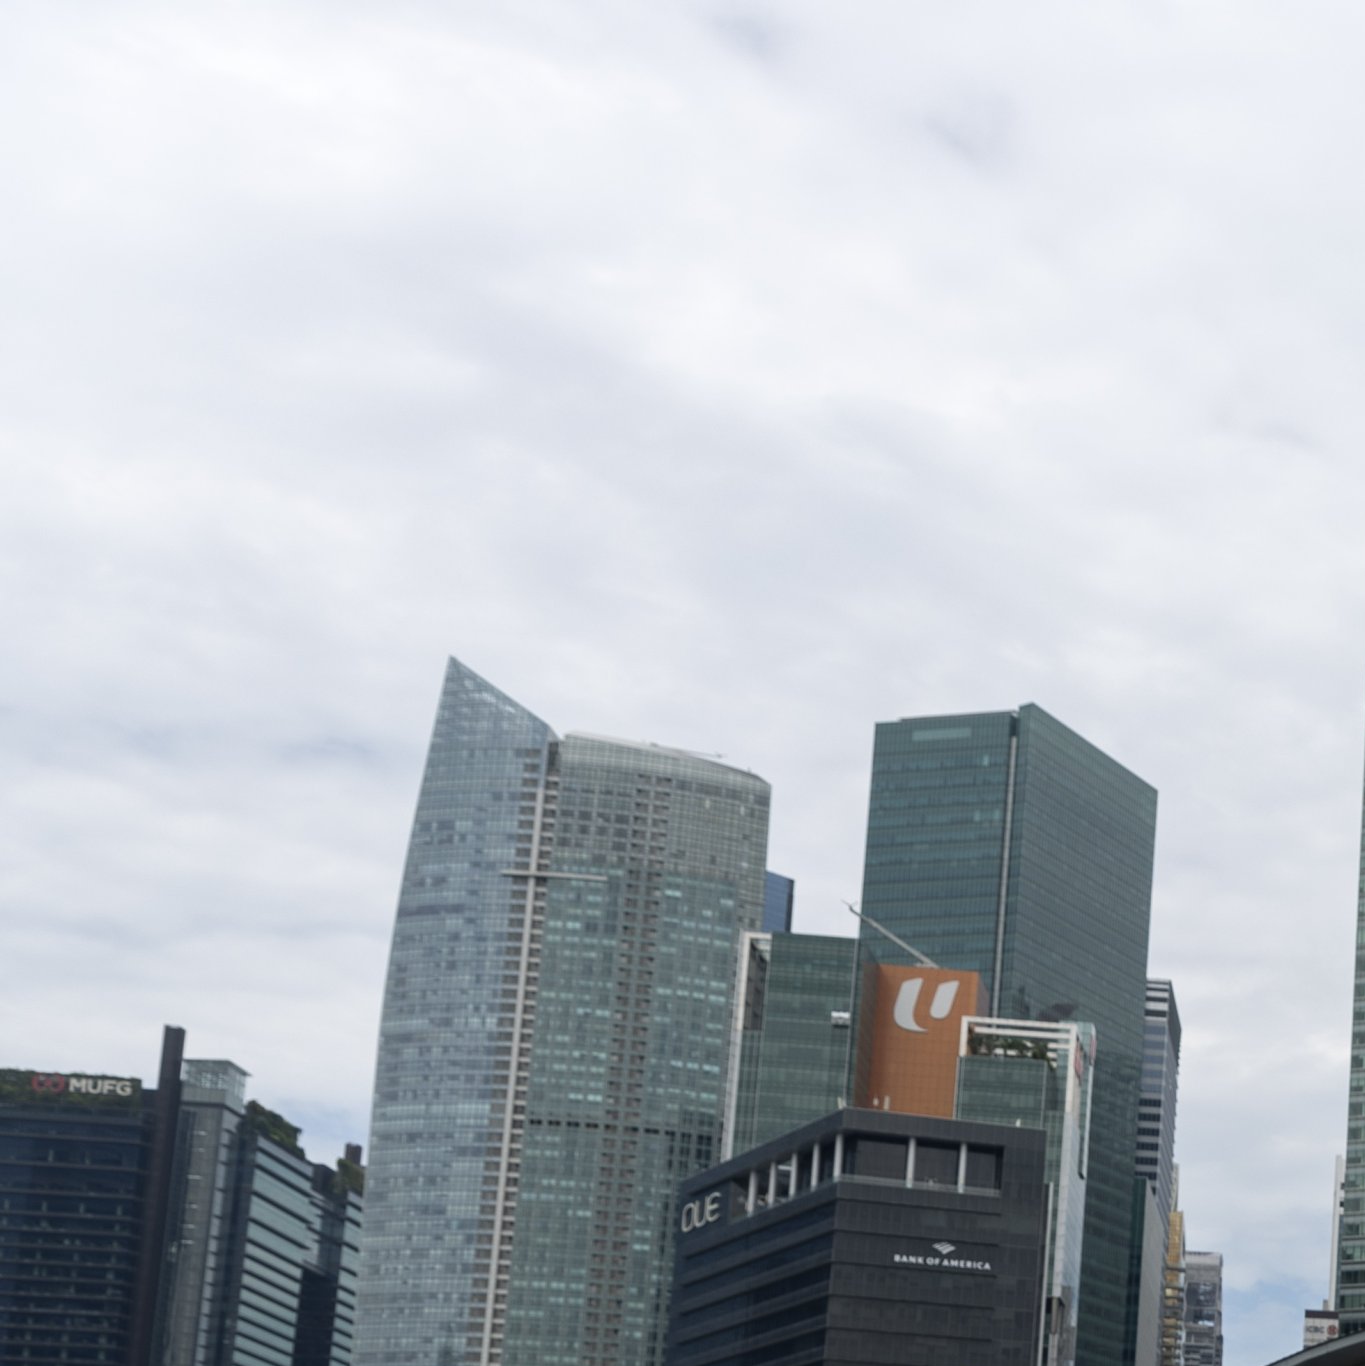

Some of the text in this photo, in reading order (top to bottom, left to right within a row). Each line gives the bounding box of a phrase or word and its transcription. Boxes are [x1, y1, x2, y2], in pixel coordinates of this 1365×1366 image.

[68, 1076, 133, 1097] MUFG
[681, 1191, 722, 1233] OUE
[893, 1253, 992, 1271] BANK OF AMERICA
